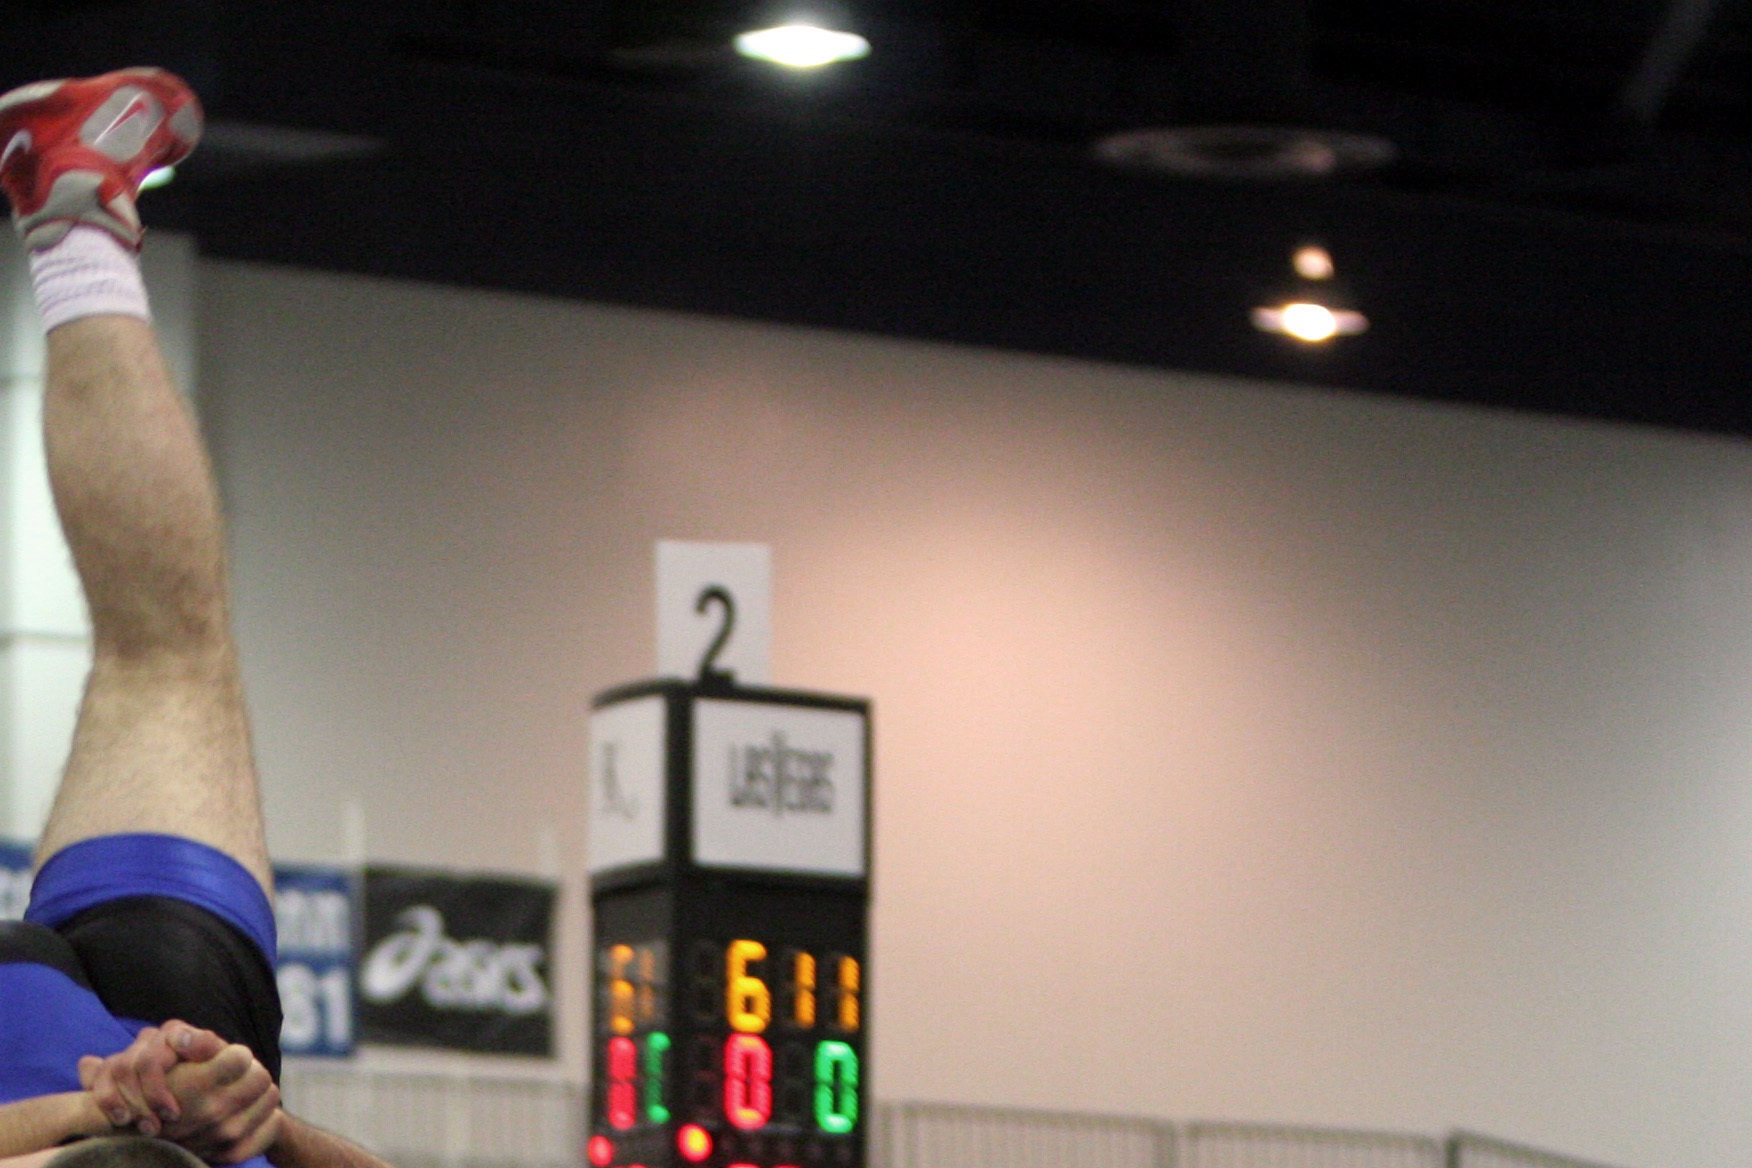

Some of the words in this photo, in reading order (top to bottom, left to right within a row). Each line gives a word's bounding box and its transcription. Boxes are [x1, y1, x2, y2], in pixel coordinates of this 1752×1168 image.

[696, 584, 736, 688] 2
[724, 1032, 773, 1131] 0
[815, 1039, 860, 1134] 0
